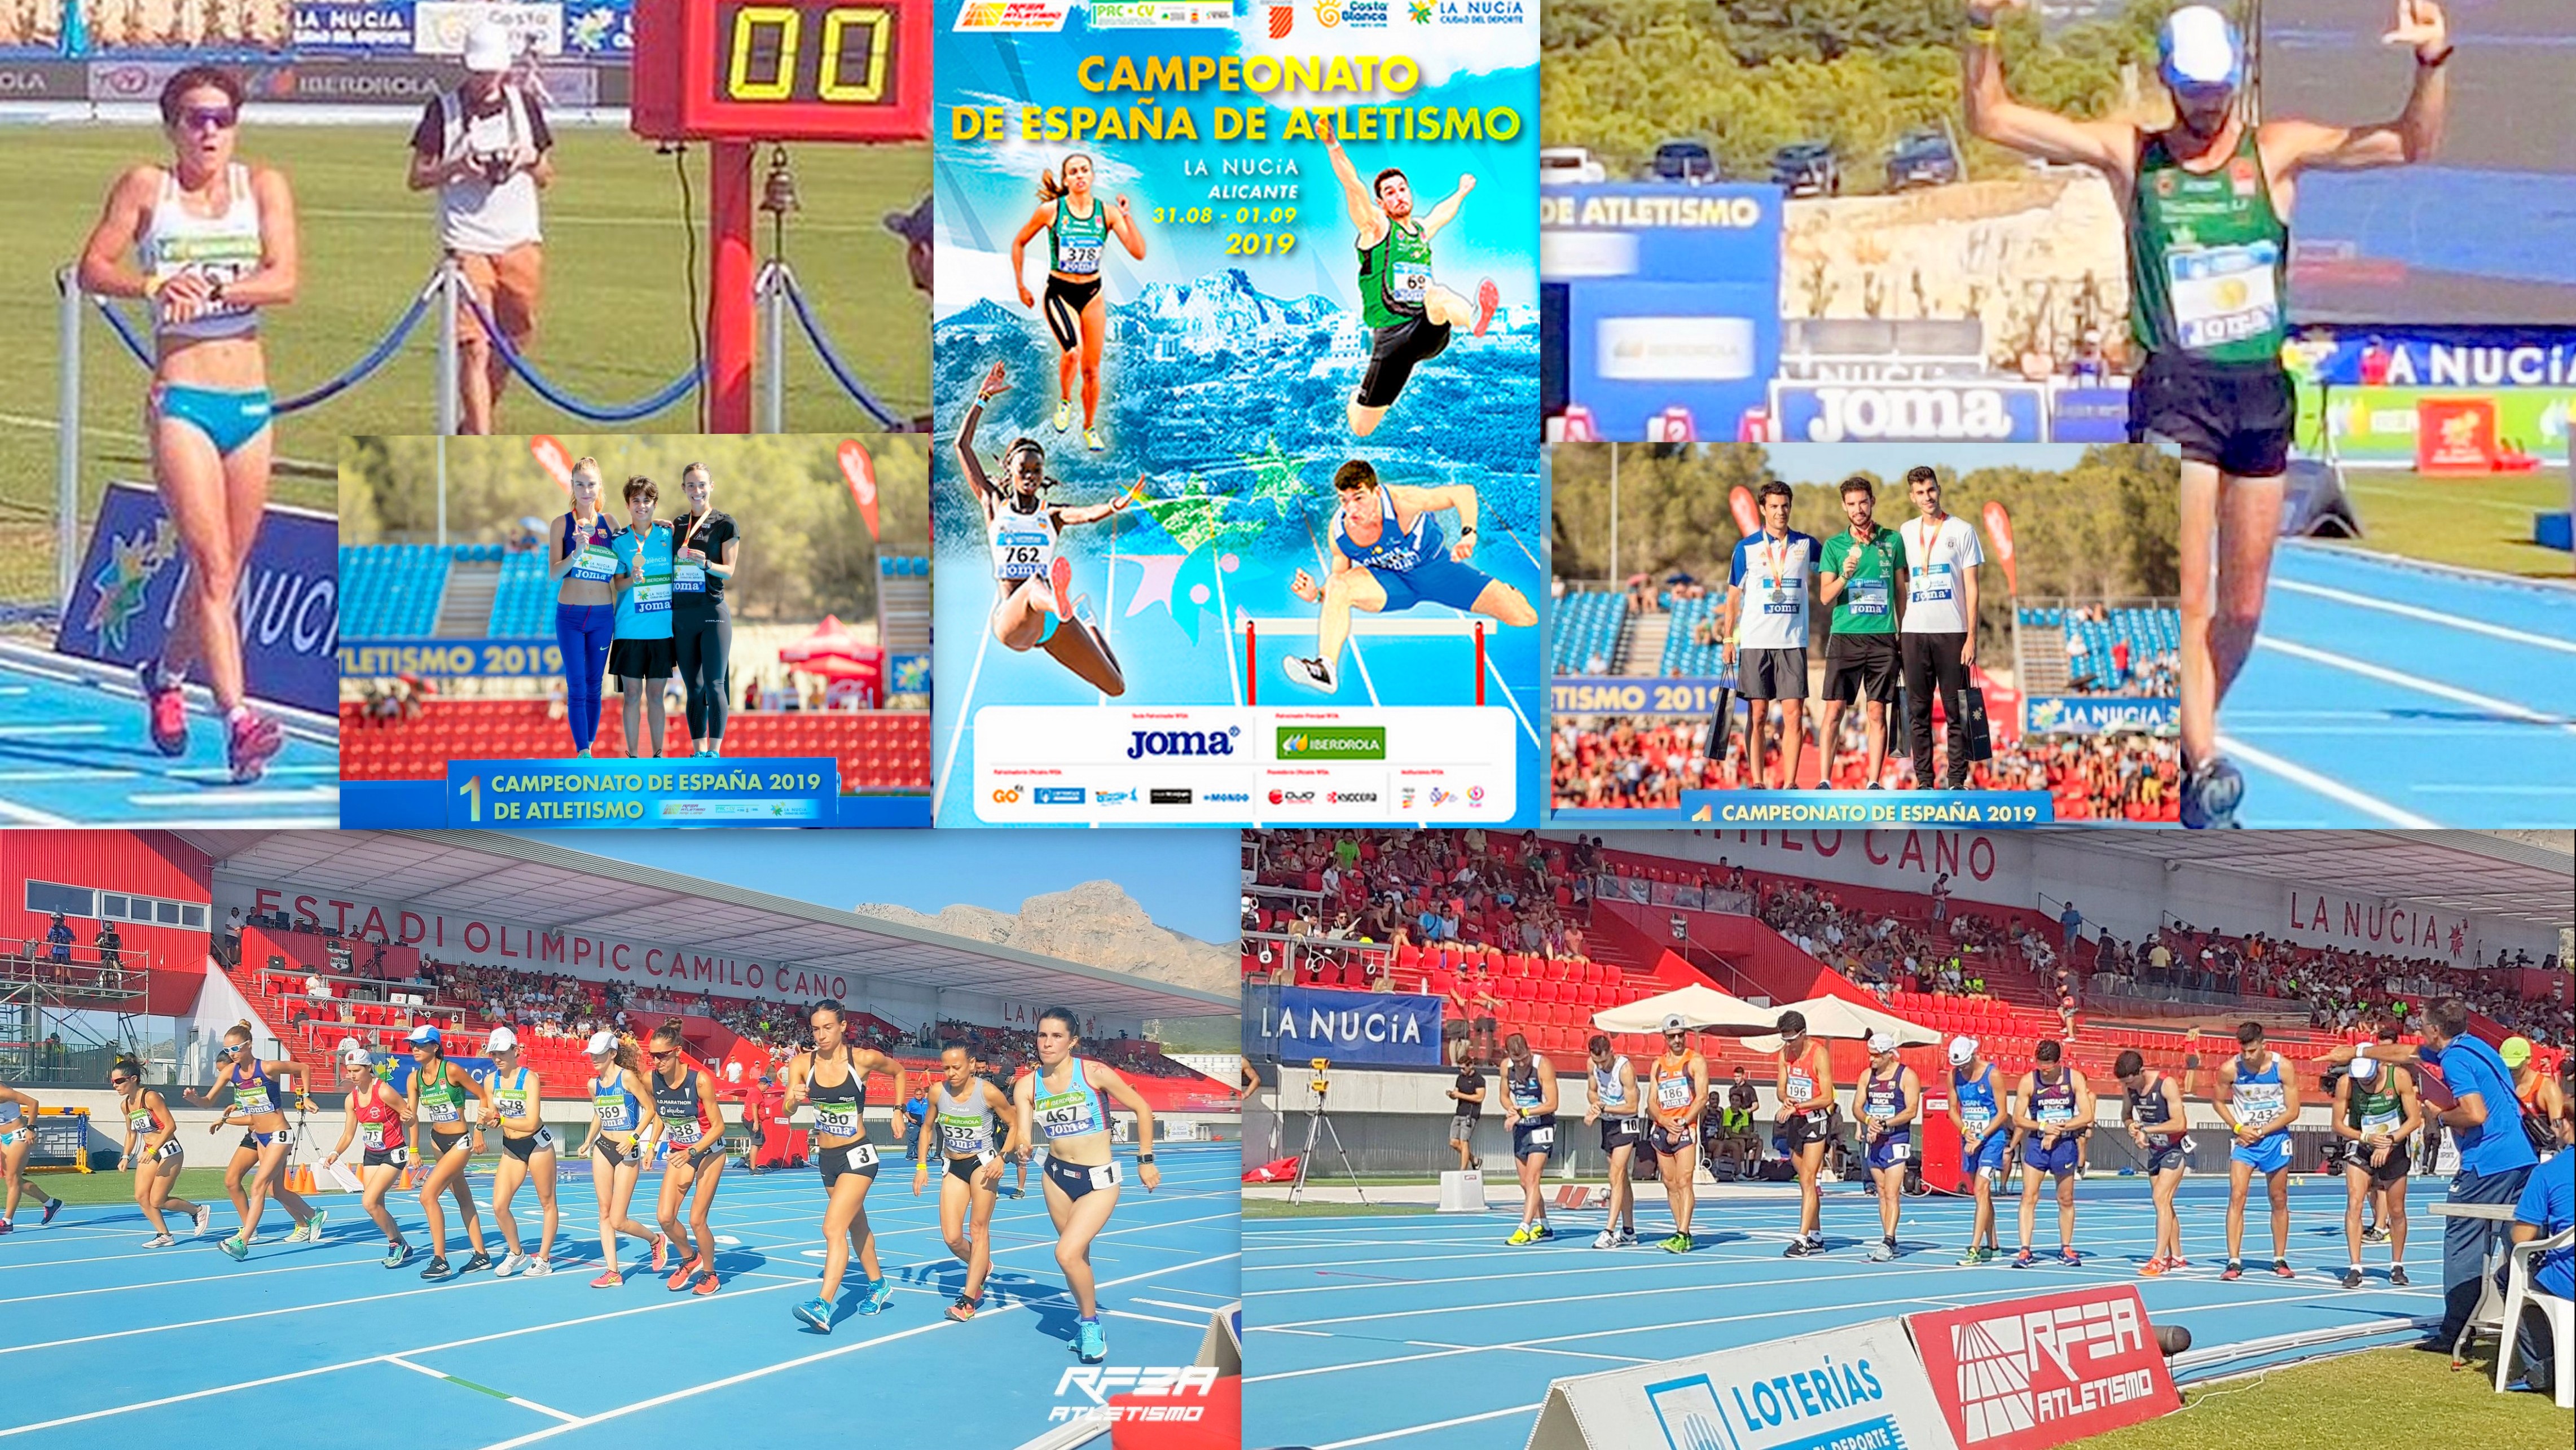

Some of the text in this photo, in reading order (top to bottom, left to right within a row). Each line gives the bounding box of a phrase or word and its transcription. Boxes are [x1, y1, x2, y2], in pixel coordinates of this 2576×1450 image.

[1098, 6, 1155, 17] PRC CV
[1440, 1, 1458, 14] LA
[294, 11, 318, 28] LA
[1342, 11, 1387, 21] Blanca
[1077, 55, 1419, 93] CAMPEONATO
[300, 77, 438, 94] IBERDROLA
[953, 98, 1521, 142] DE ESPAÑA DE ATLETISMO
[1185, 159, 1207, 177] LA
[1208, 183, 1298, 200] ALICANTE
[1152, 207, 1213, 225] 31.08
[1236, 207, 1297, 224] 01.09
[1540, 197, 1759, 226] DE ATLETISMO
[1224, 234, 1295, 256] 2019
[1067, 248, 1096, 261] 378
[590, 547, 614, 556] IBERDROLA
[1005, 547, 1040, 563] 762
[645, 556, 666, 565] alència
[575, 569, 606, 581] Joma
[639, 600, 671, 613] Joma
[1768, 604, 1797, 613] Joma
[1850, 604, 1882, 614] Joma
[485, 646, 564, 671] 2019
[1551, 686, 1646, 711] TISMO
[2065, 708, 2087, 722] LA
[1127, 731, 1233, 759] Joma
[1310, 740, 1380, 750] IBERDROLA
[491, 769, 821, 793] CAMPEONATO DE ESPAÑA 2019
[460, 775, 481, 821] 1
[992, 789, 1019, 803] GO
[495, 800, 644, 820] DE ATLETISMO
[1722, 804, 1866, 822] CAMPEONATO
[1871, 805, 1896, 822] DE
[1901, 801, 1981, 822] ESPAÑA
[1987, 805, 2037, 822] 2019
[1865, 829, 1995, 881] CANO
[2291, 891, 2439, 950] LA NUCIA
[256, 887, 847, 999] ESTADI OLIMPIC CAMILO CANO
[1262, 1006, 1298, 1039] LA
[1663, 1087, 1683, 1099] 186
[1790, 1086, 1806, 1097] 196
[427, 1096, 449, 1105] IBERDROLA
[500, 1100, 524, 1110] 578
[1050, 1096, 1084, 1106] IBERDROLA
[247, 1105, 271, 1114] Joma
[598, 1106, 620, 1118] 569
[1045, 1106, 1078, 1124] 467
[2249, 1109, 2273, 1121] 243
[820, 1113, 849, 1125] 580
[1626, 1119, 1637, 1131] 10
[541, 1130, 551, 1141] 6
[944, 1127, 975, 1140] 532
[1048, 1121, 1089, 1137] Joma
[279, 1131, 287, 1143] 9
[162, 1141, 177, 1155] 11
[631, 1145, 639, 1158] 5
[859, 1147, 870, 1163] 3
[1900, 1145, 1906, 1157] 7
[1104, 1166, 1115, 1184] 1
[2030, 1296, 2143, 1382] RFEA
[1731, 1354, 1884, 1432] LOTERÍAS
[2037, 1367, 2153, 1424] ATLETISMO
[1831, 1427, 1891, 1450] DEPORTE
